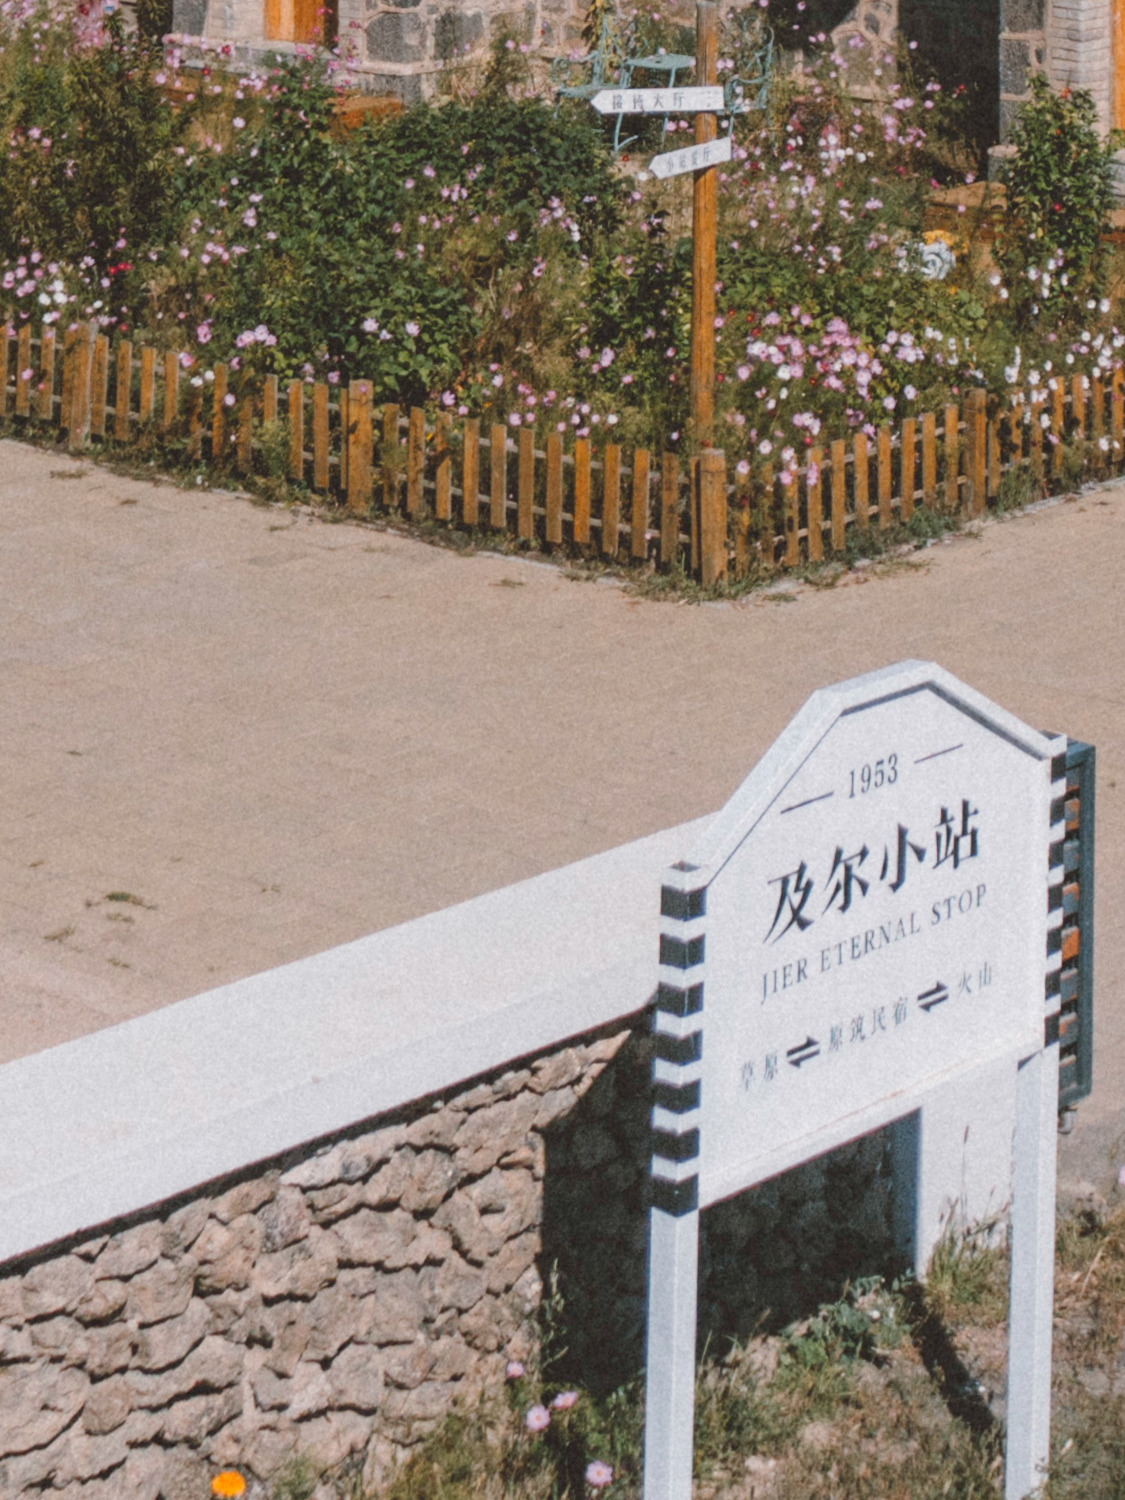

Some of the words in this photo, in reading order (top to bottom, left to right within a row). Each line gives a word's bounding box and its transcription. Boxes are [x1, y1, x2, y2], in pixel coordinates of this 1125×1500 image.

[613, 93, 684, 110] 接待大厅
[848, 753, 900, 798] 1953
[762, 798, 982, 944] 及尔小站
[760, 957, 808, 1005] JIER
[819, 912, 921, 973] ETERNAL
[931, 883, 987, 927] STOP
[740, 1051, 779, 1091] 草原
[828, 996, 909, 1054] 原筑民宿
[958, 962, 993, 996] 火山
